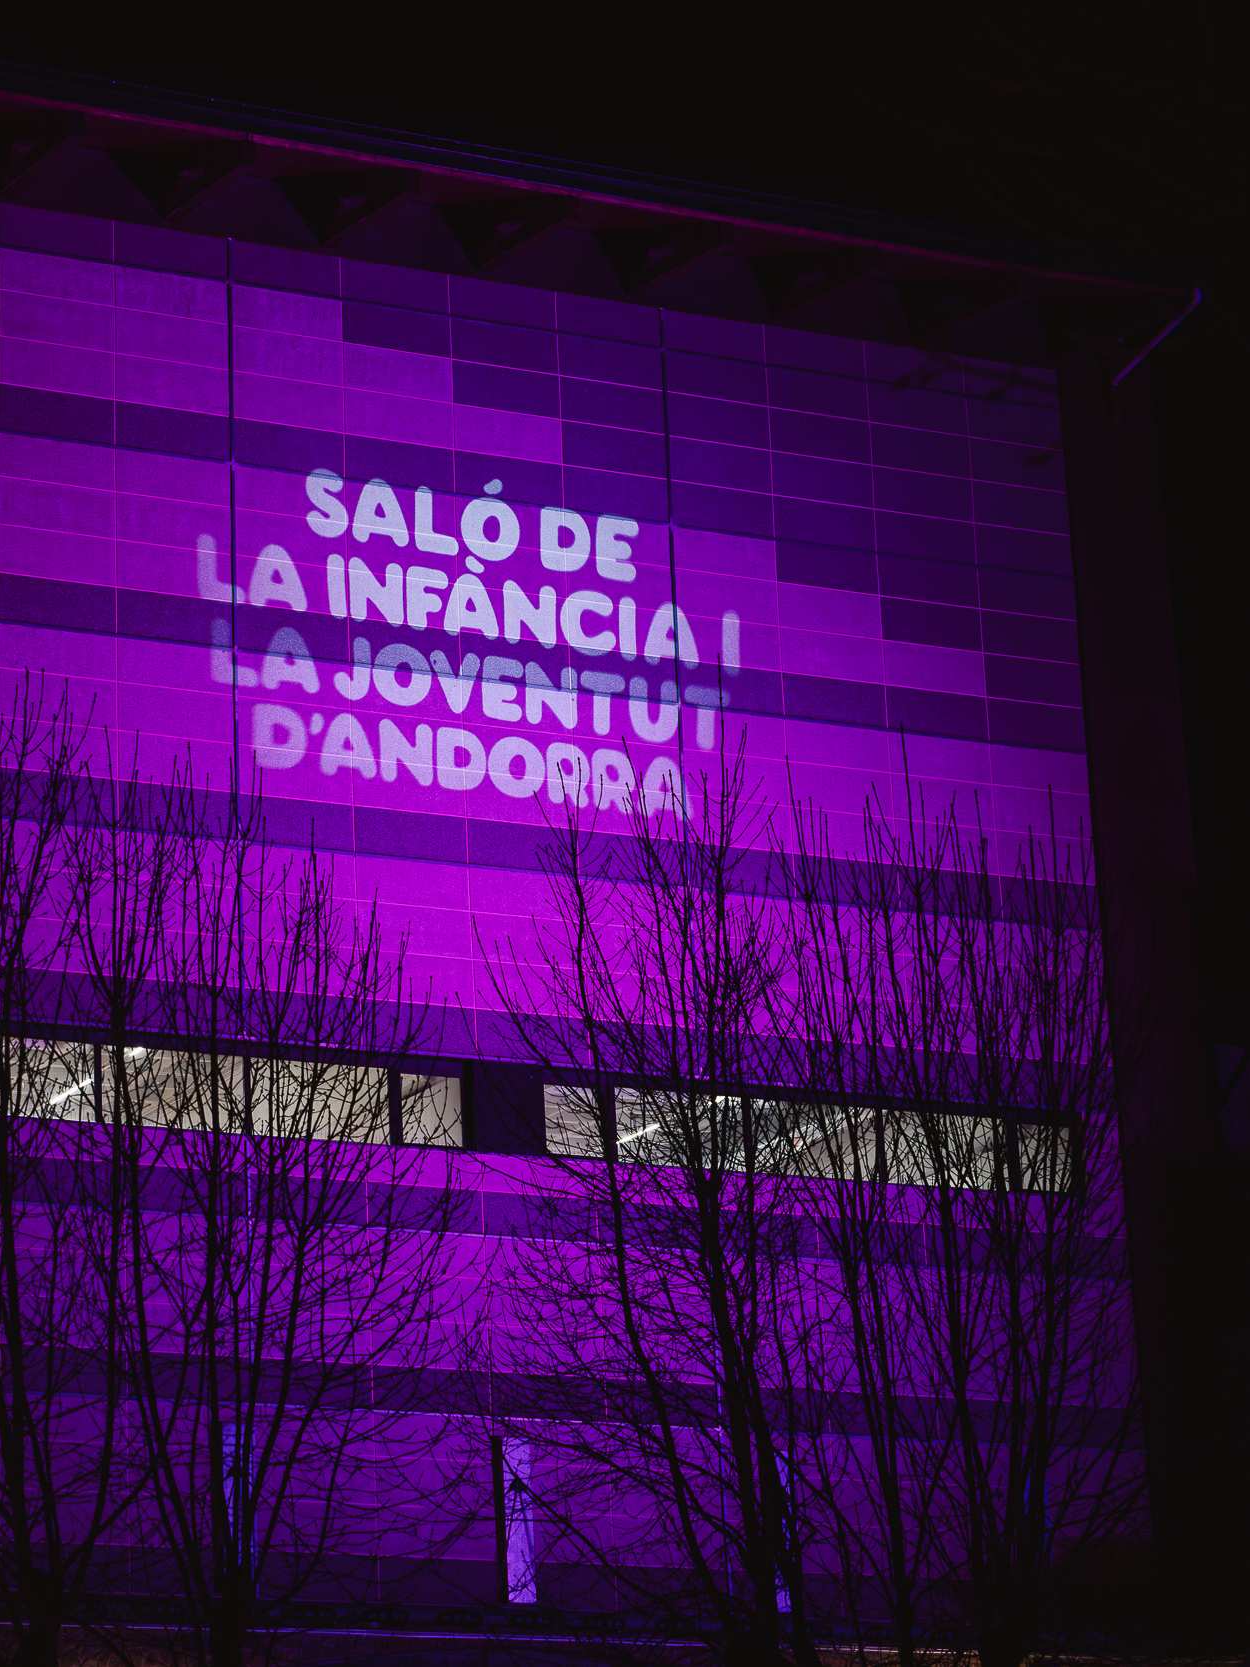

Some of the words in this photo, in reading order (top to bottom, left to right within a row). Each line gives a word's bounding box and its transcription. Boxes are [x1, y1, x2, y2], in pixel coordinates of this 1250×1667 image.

[305, 468, 521, 562] SALÓ
[540, 506, 639, 583] DE
[196, 533, 308, 612] LA
[326, 553, 700, 670] INFÀNCIA
[721, 610, 741, 675] I
[210, 618, 320, 694] LA
[333, 637, 731, 751] JOVENTUT
[252, 703, 694, 821] D'ANDORRA
